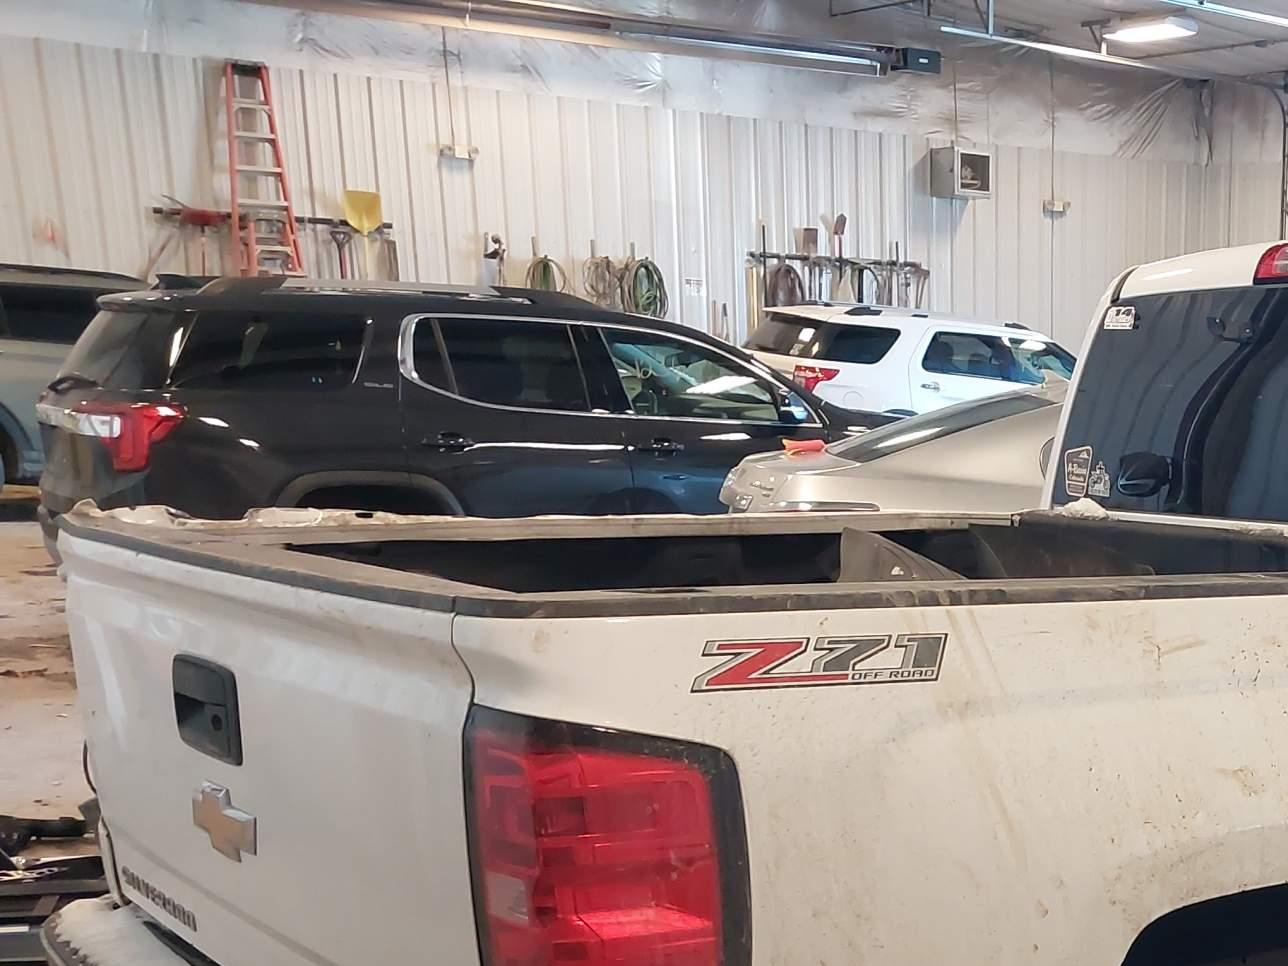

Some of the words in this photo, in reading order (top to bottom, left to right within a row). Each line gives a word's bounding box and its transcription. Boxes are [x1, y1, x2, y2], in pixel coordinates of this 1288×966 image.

[690, 633, 948, 693] Z71
[851, 672, 884, 681] OFF
[889, 669, 935, 679] ROAD
